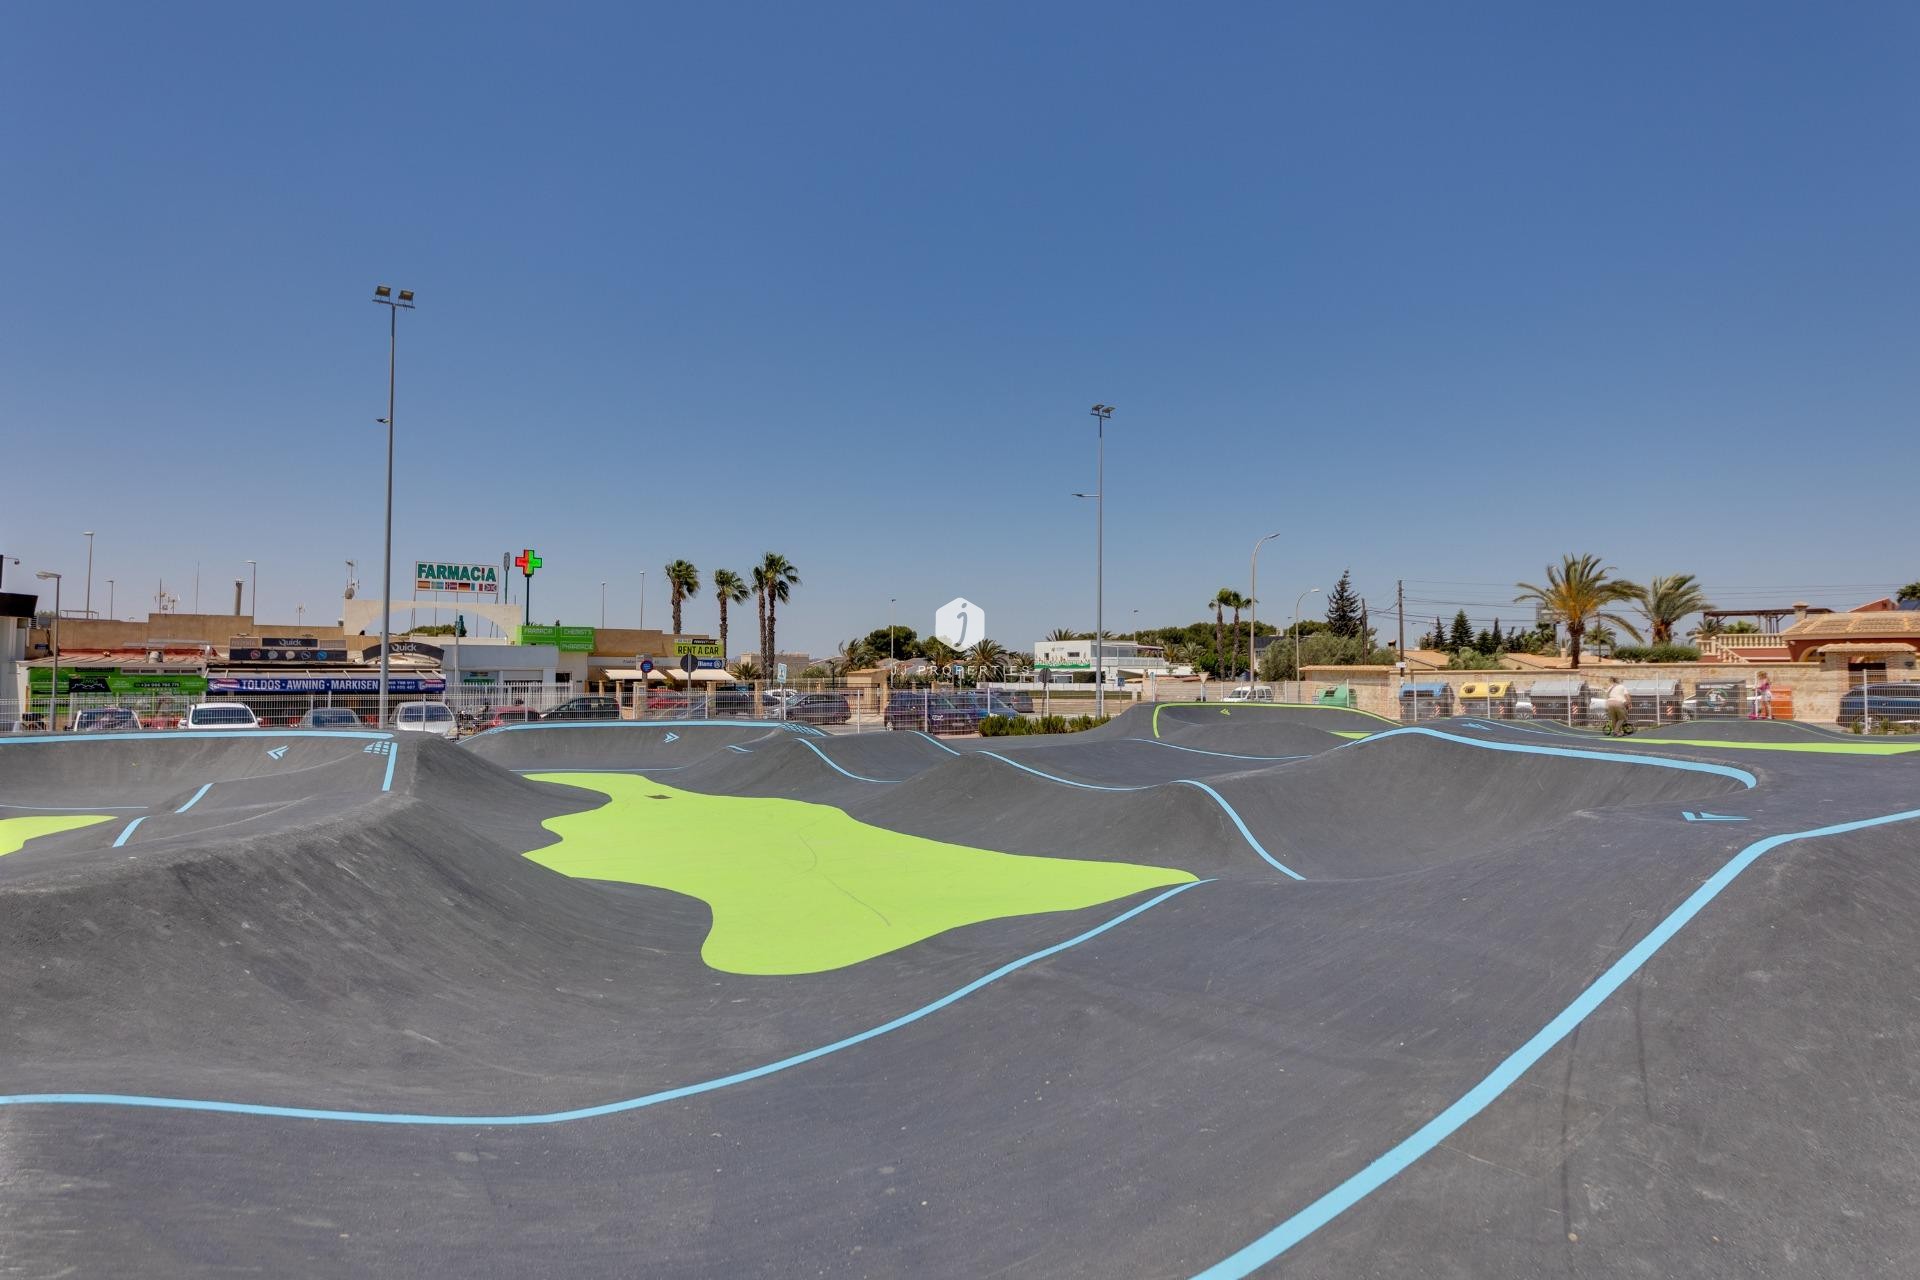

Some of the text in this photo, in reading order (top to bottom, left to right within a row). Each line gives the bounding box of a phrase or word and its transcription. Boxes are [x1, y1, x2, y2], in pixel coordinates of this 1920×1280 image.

[418, 564, 497, 583] FARMACIA
[279, 639, 302, 648] Quick
[391, 643, 417, 653] Quick
[677, 646, 719, 655] RENT A CAR
[242, 680, 282, 690] TOLDOS
[286, 680, 325, 690] AWNING
[331, 680, 379, 690] MARKISEN
